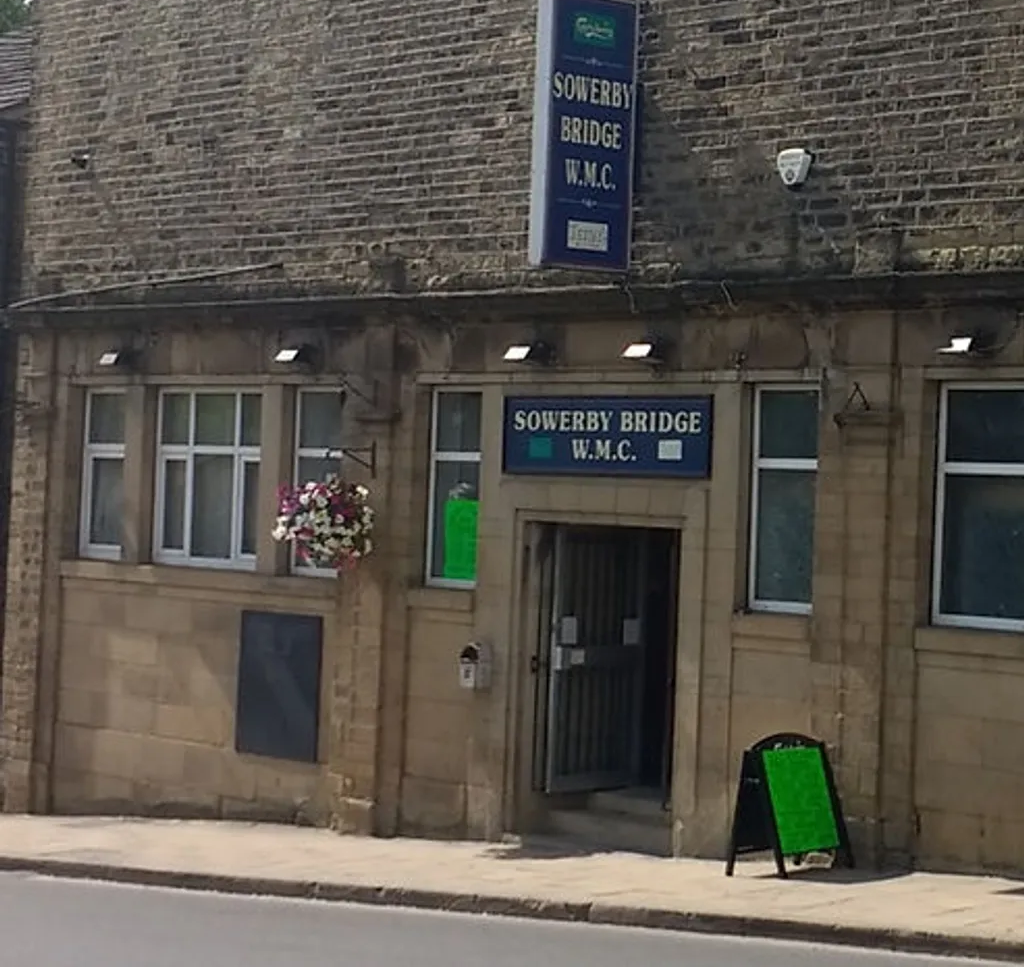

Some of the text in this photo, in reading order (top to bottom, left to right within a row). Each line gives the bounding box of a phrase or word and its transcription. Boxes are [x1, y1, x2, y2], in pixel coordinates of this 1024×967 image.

[553, 72, 632, 109] SOWERBY
[561, 116, 622, 149] BRIDGE
[565, 158, 616, 191] W.M.C.
[514, 410, 702, 434] SOWERBY BRIDGE
[572, 439, 637, 462] W.M.C.
